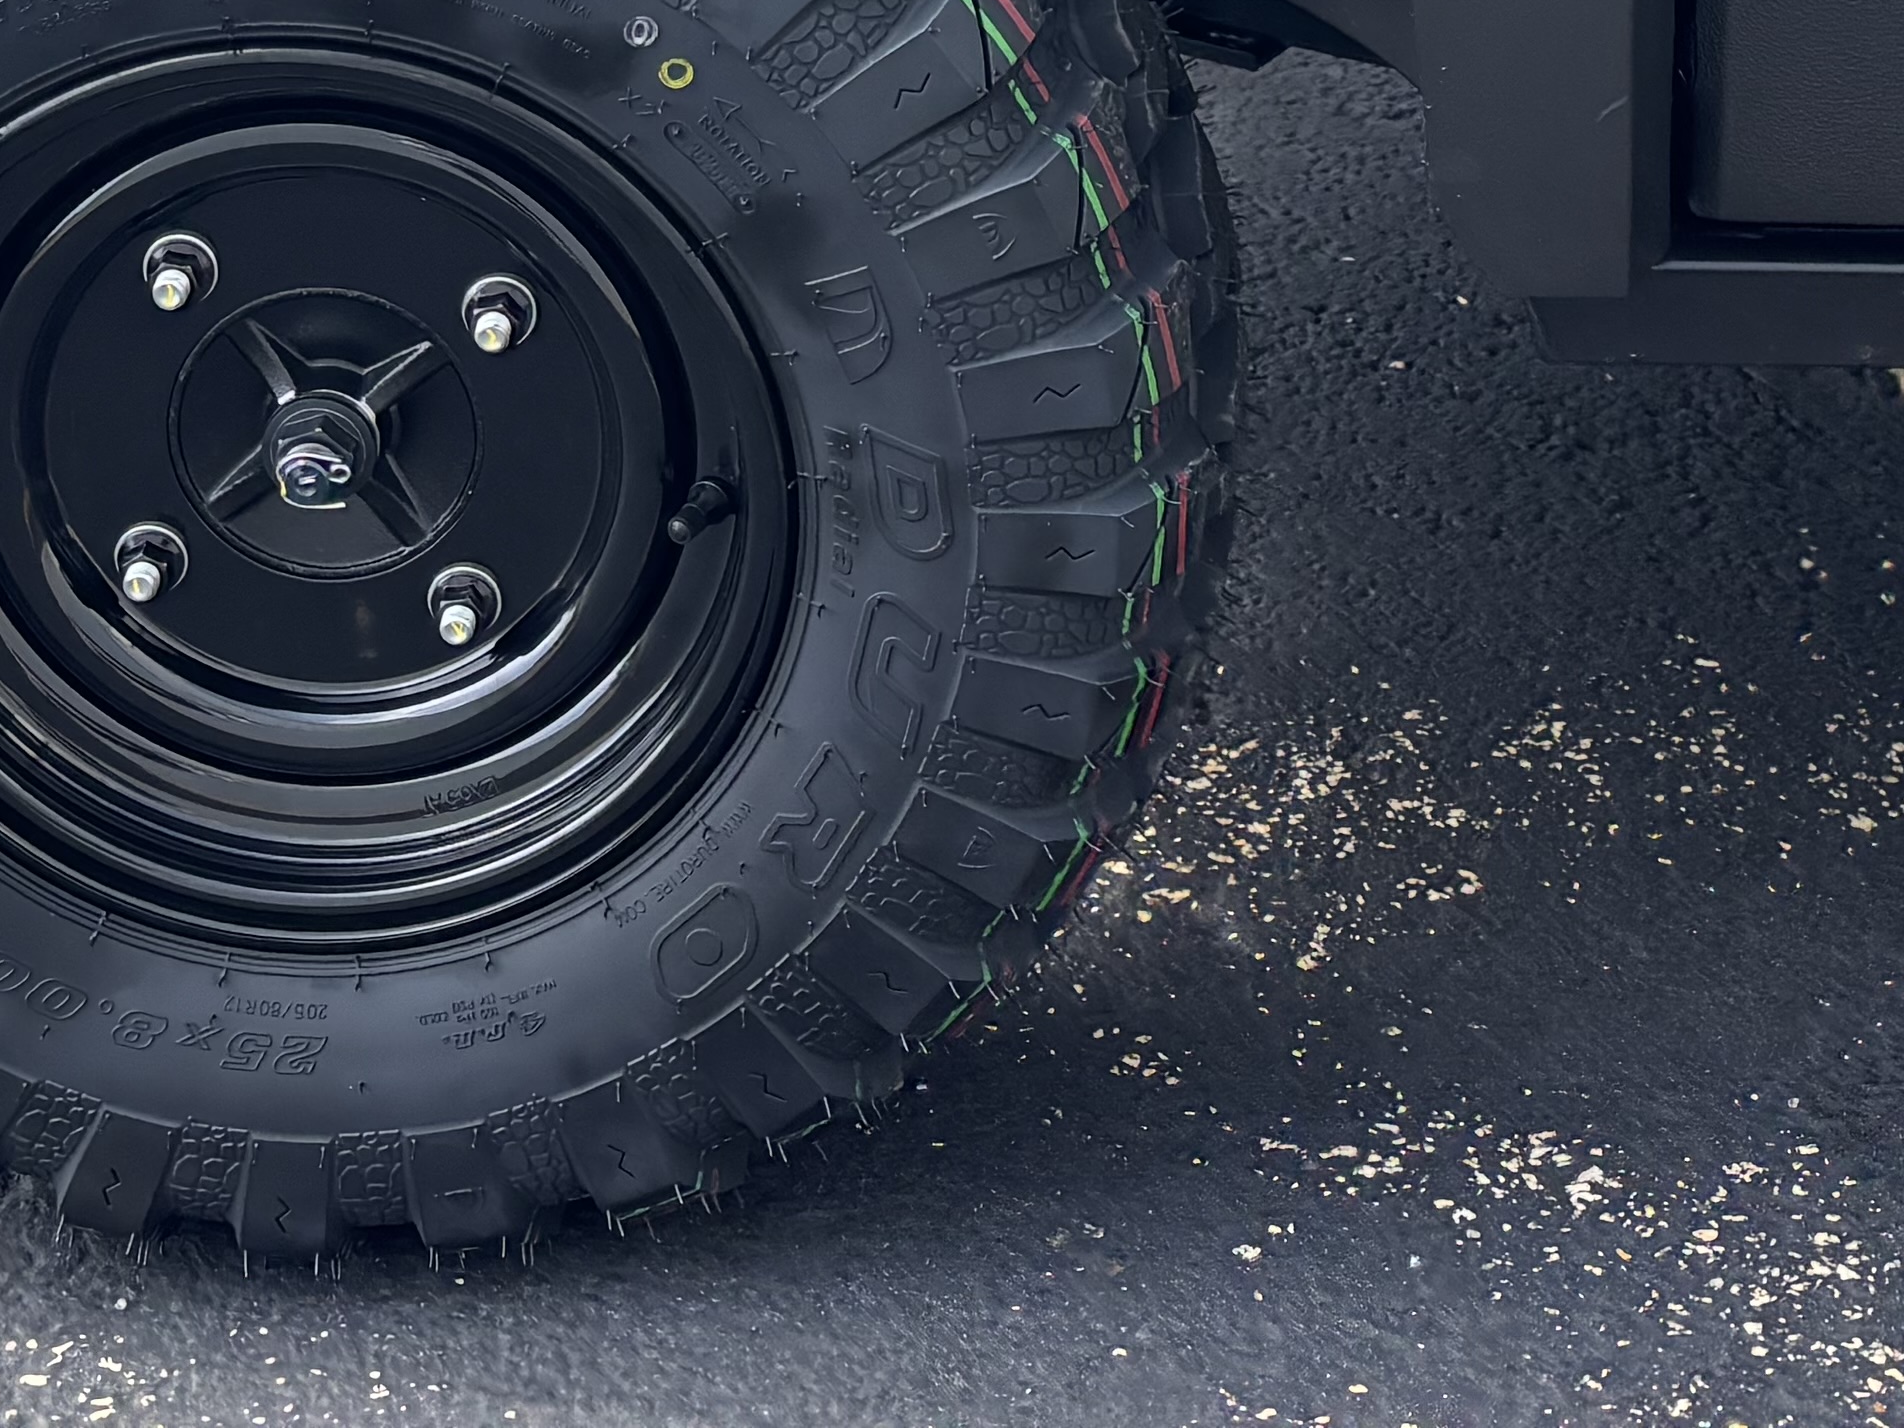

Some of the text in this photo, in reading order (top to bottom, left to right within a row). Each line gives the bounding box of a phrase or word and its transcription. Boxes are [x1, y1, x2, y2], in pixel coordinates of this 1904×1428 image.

[697, 111, 771, 186] ROTATION
[650, 423, 955, 1008] DURO
[224, 994, 329, 1020] 205/80R12
